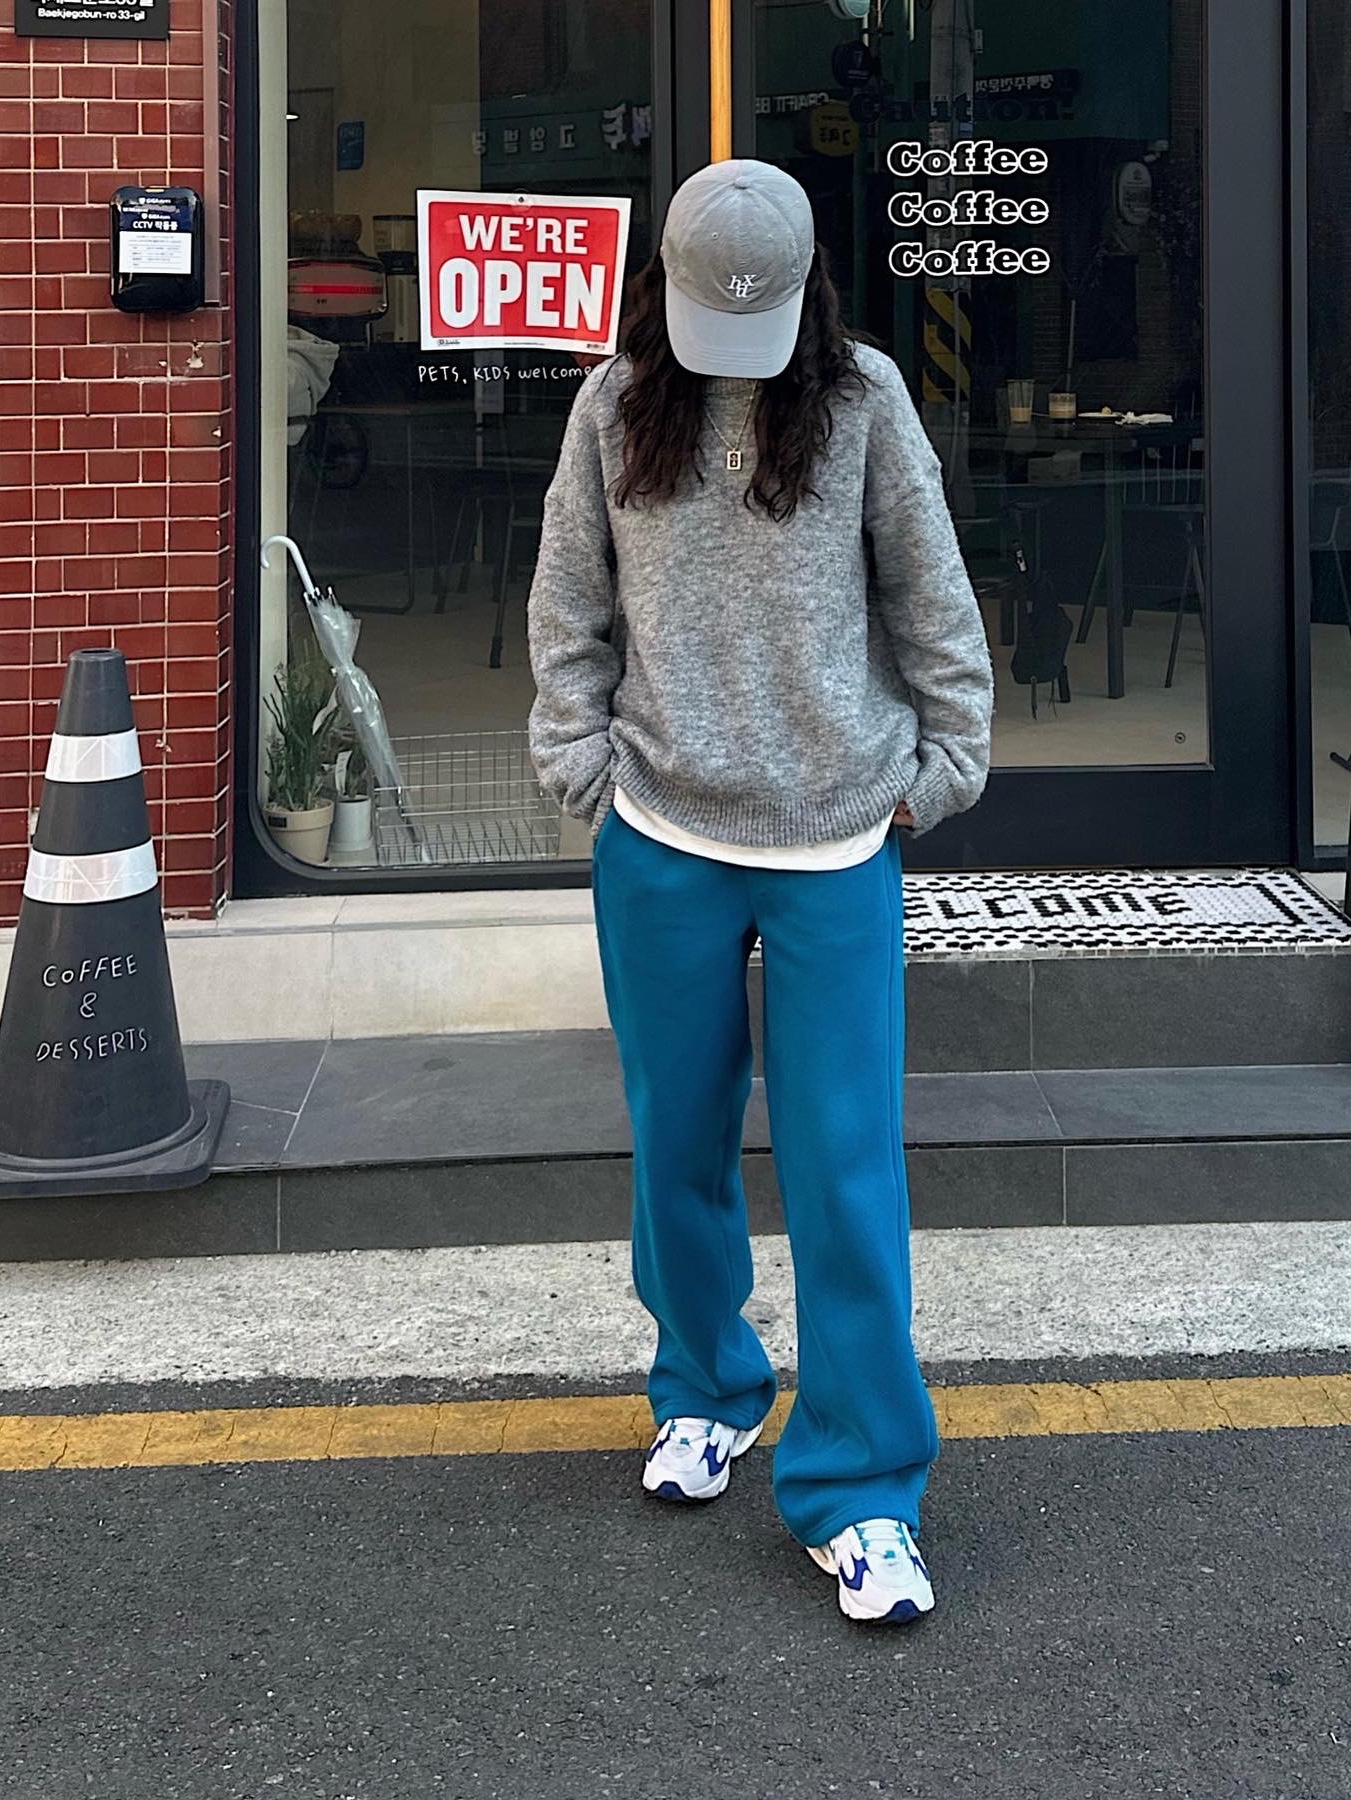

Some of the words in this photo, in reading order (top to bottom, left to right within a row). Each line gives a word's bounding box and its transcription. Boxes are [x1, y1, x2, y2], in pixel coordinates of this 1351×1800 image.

[37, 7, 117, 20] Baekjegobun-ro
[117, 10, 146, 21] 33-gil
[887, 140, 1048, 177] Coffee
[132, 221, 153, 229] CCTV
[888, 190, 1050, 226] Coffee
[888, 240, 1051, 277] Coffee
[439, 257, 606, 332] OPEN
[418, 365, 467, 384] PETS,
[473, 366, 510, 382] KIDS
[518, 366, 592, 380] welcome
[79, 992, 97, 1018] &
[36, 1028, 148, 1062] DESSERTS
